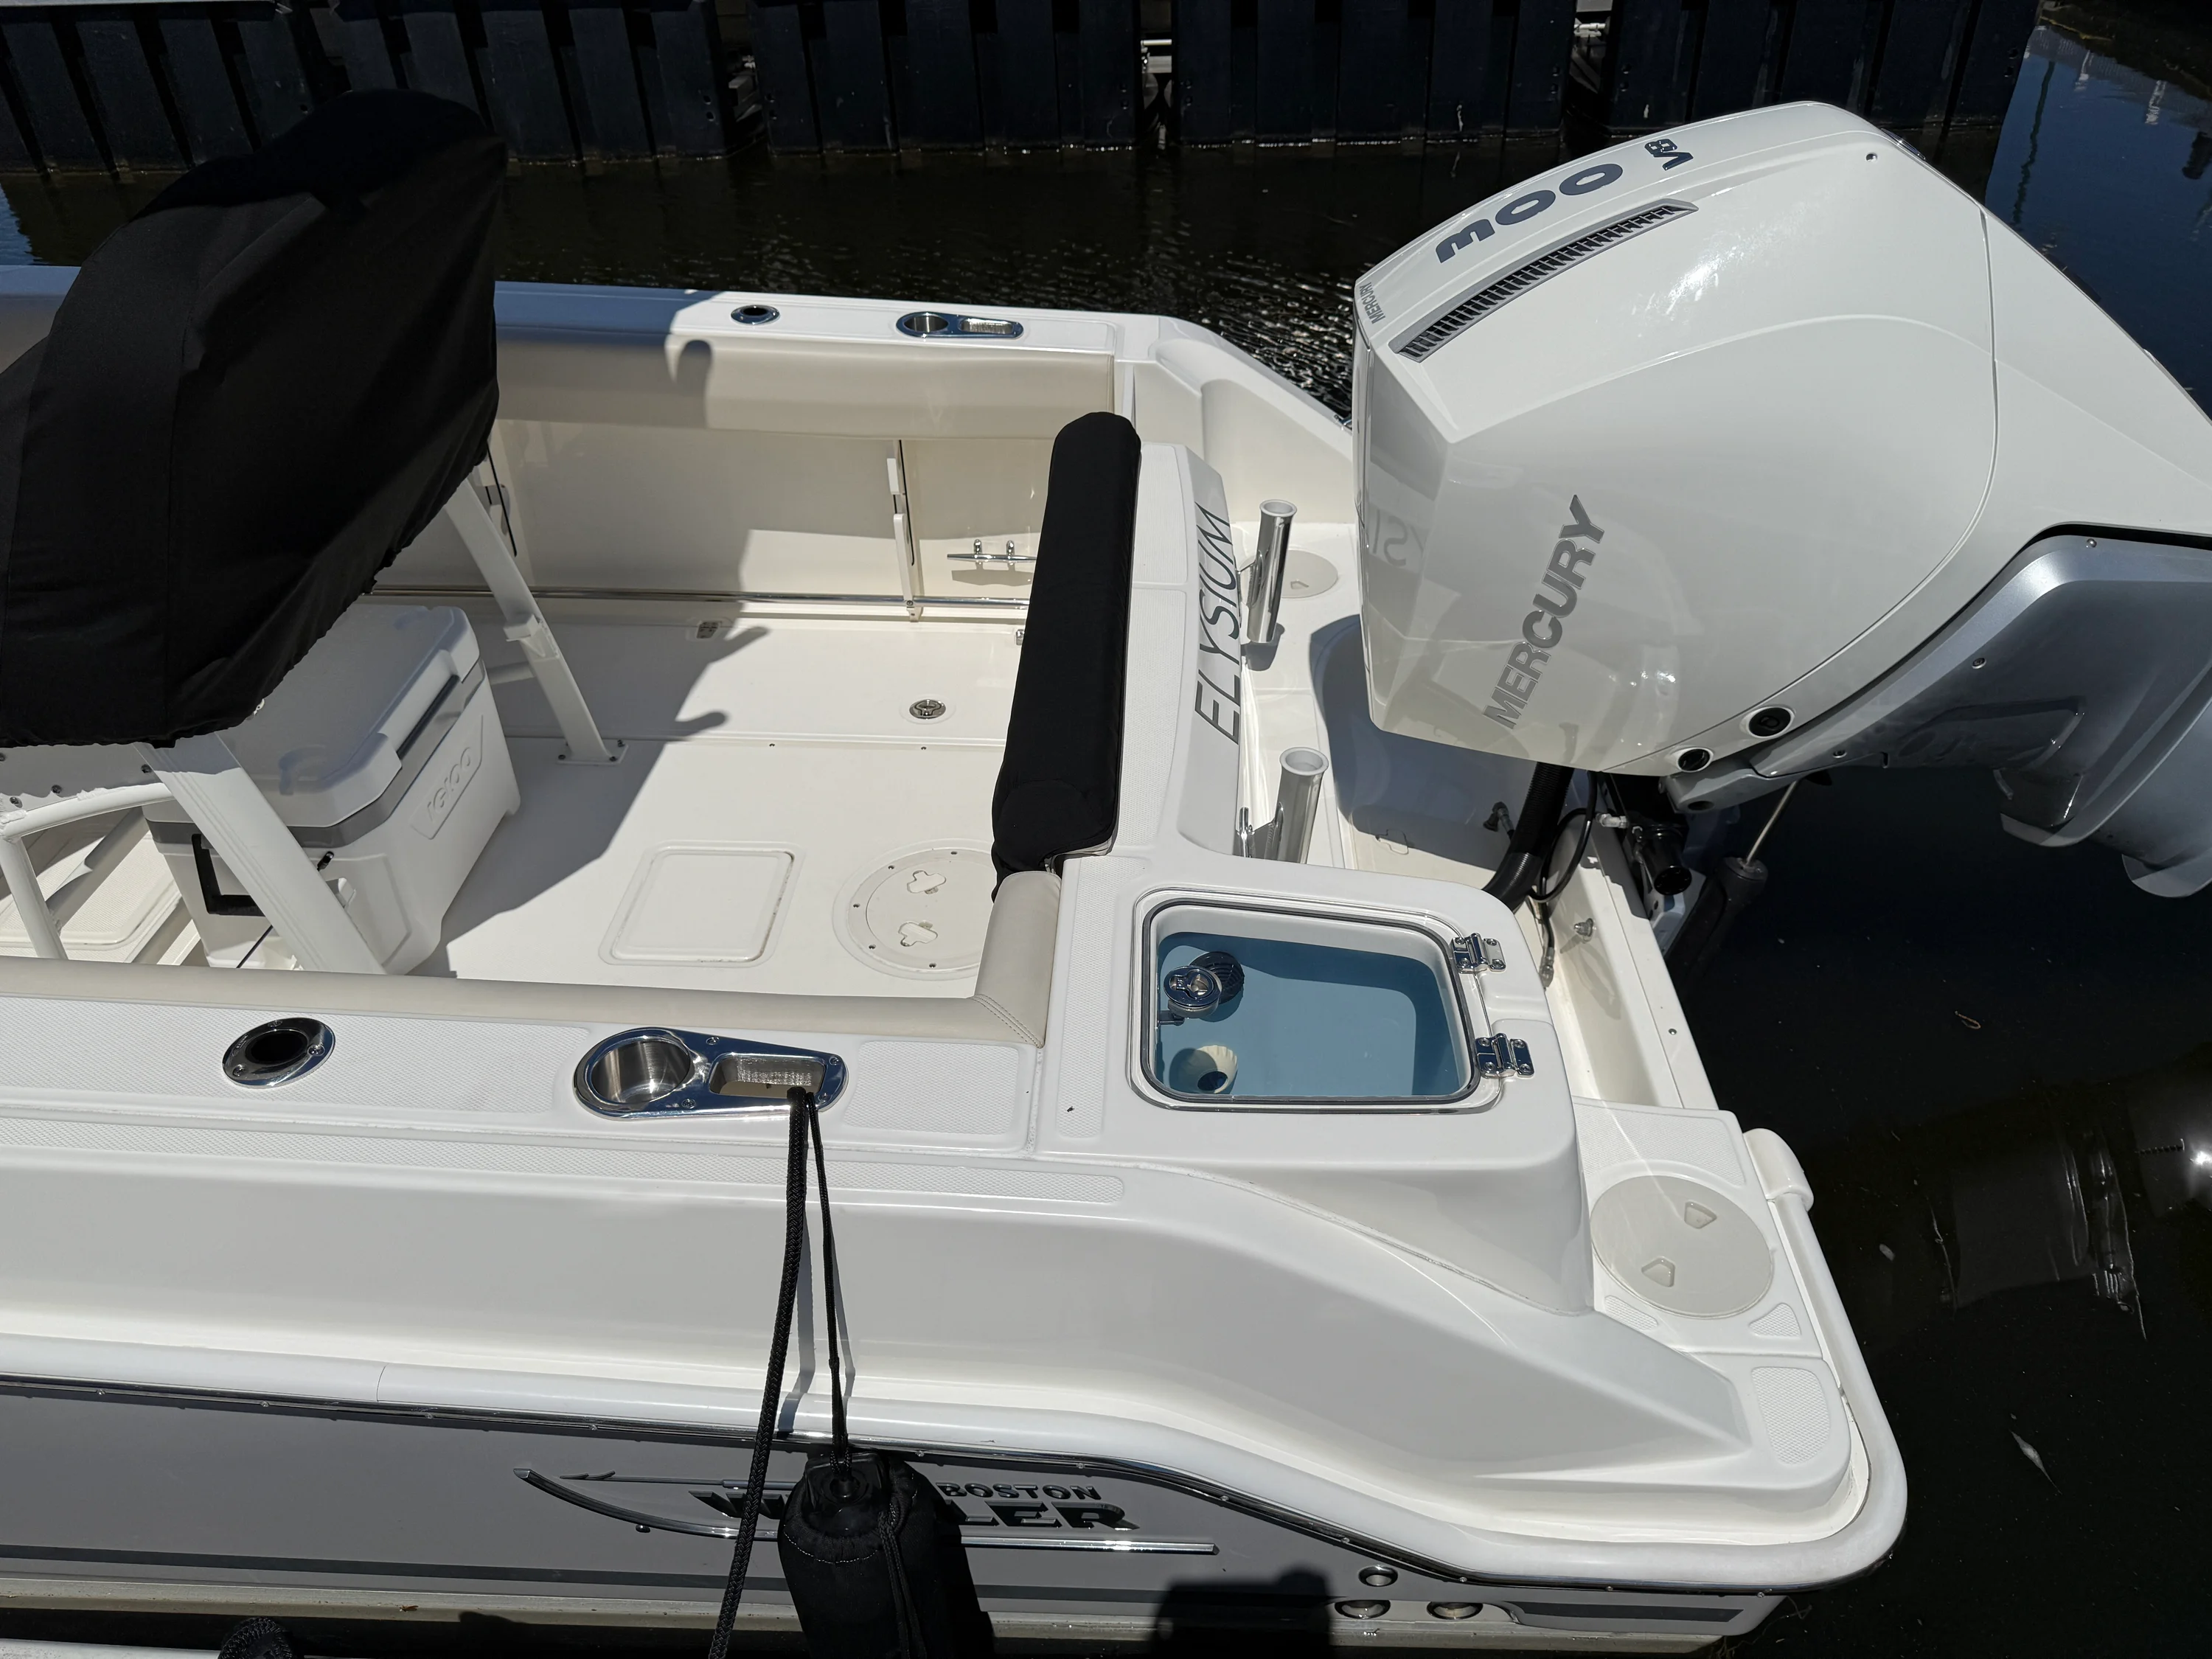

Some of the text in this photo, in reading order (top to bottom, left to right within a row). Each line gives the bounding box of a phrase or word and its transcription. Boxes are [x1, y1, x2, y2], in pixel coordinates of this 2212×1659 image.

[1644, 138, 1694, 171] V8
[1359, 282, 1386, 324] MERCURY
[1194, 501, 1241, 745] ELYSIUM
[1481, 494, 1605, 730] MERCURY
[426, 746, 472, 824] IGLOO
[935, 1482, 1102, 1500] BOSTON
